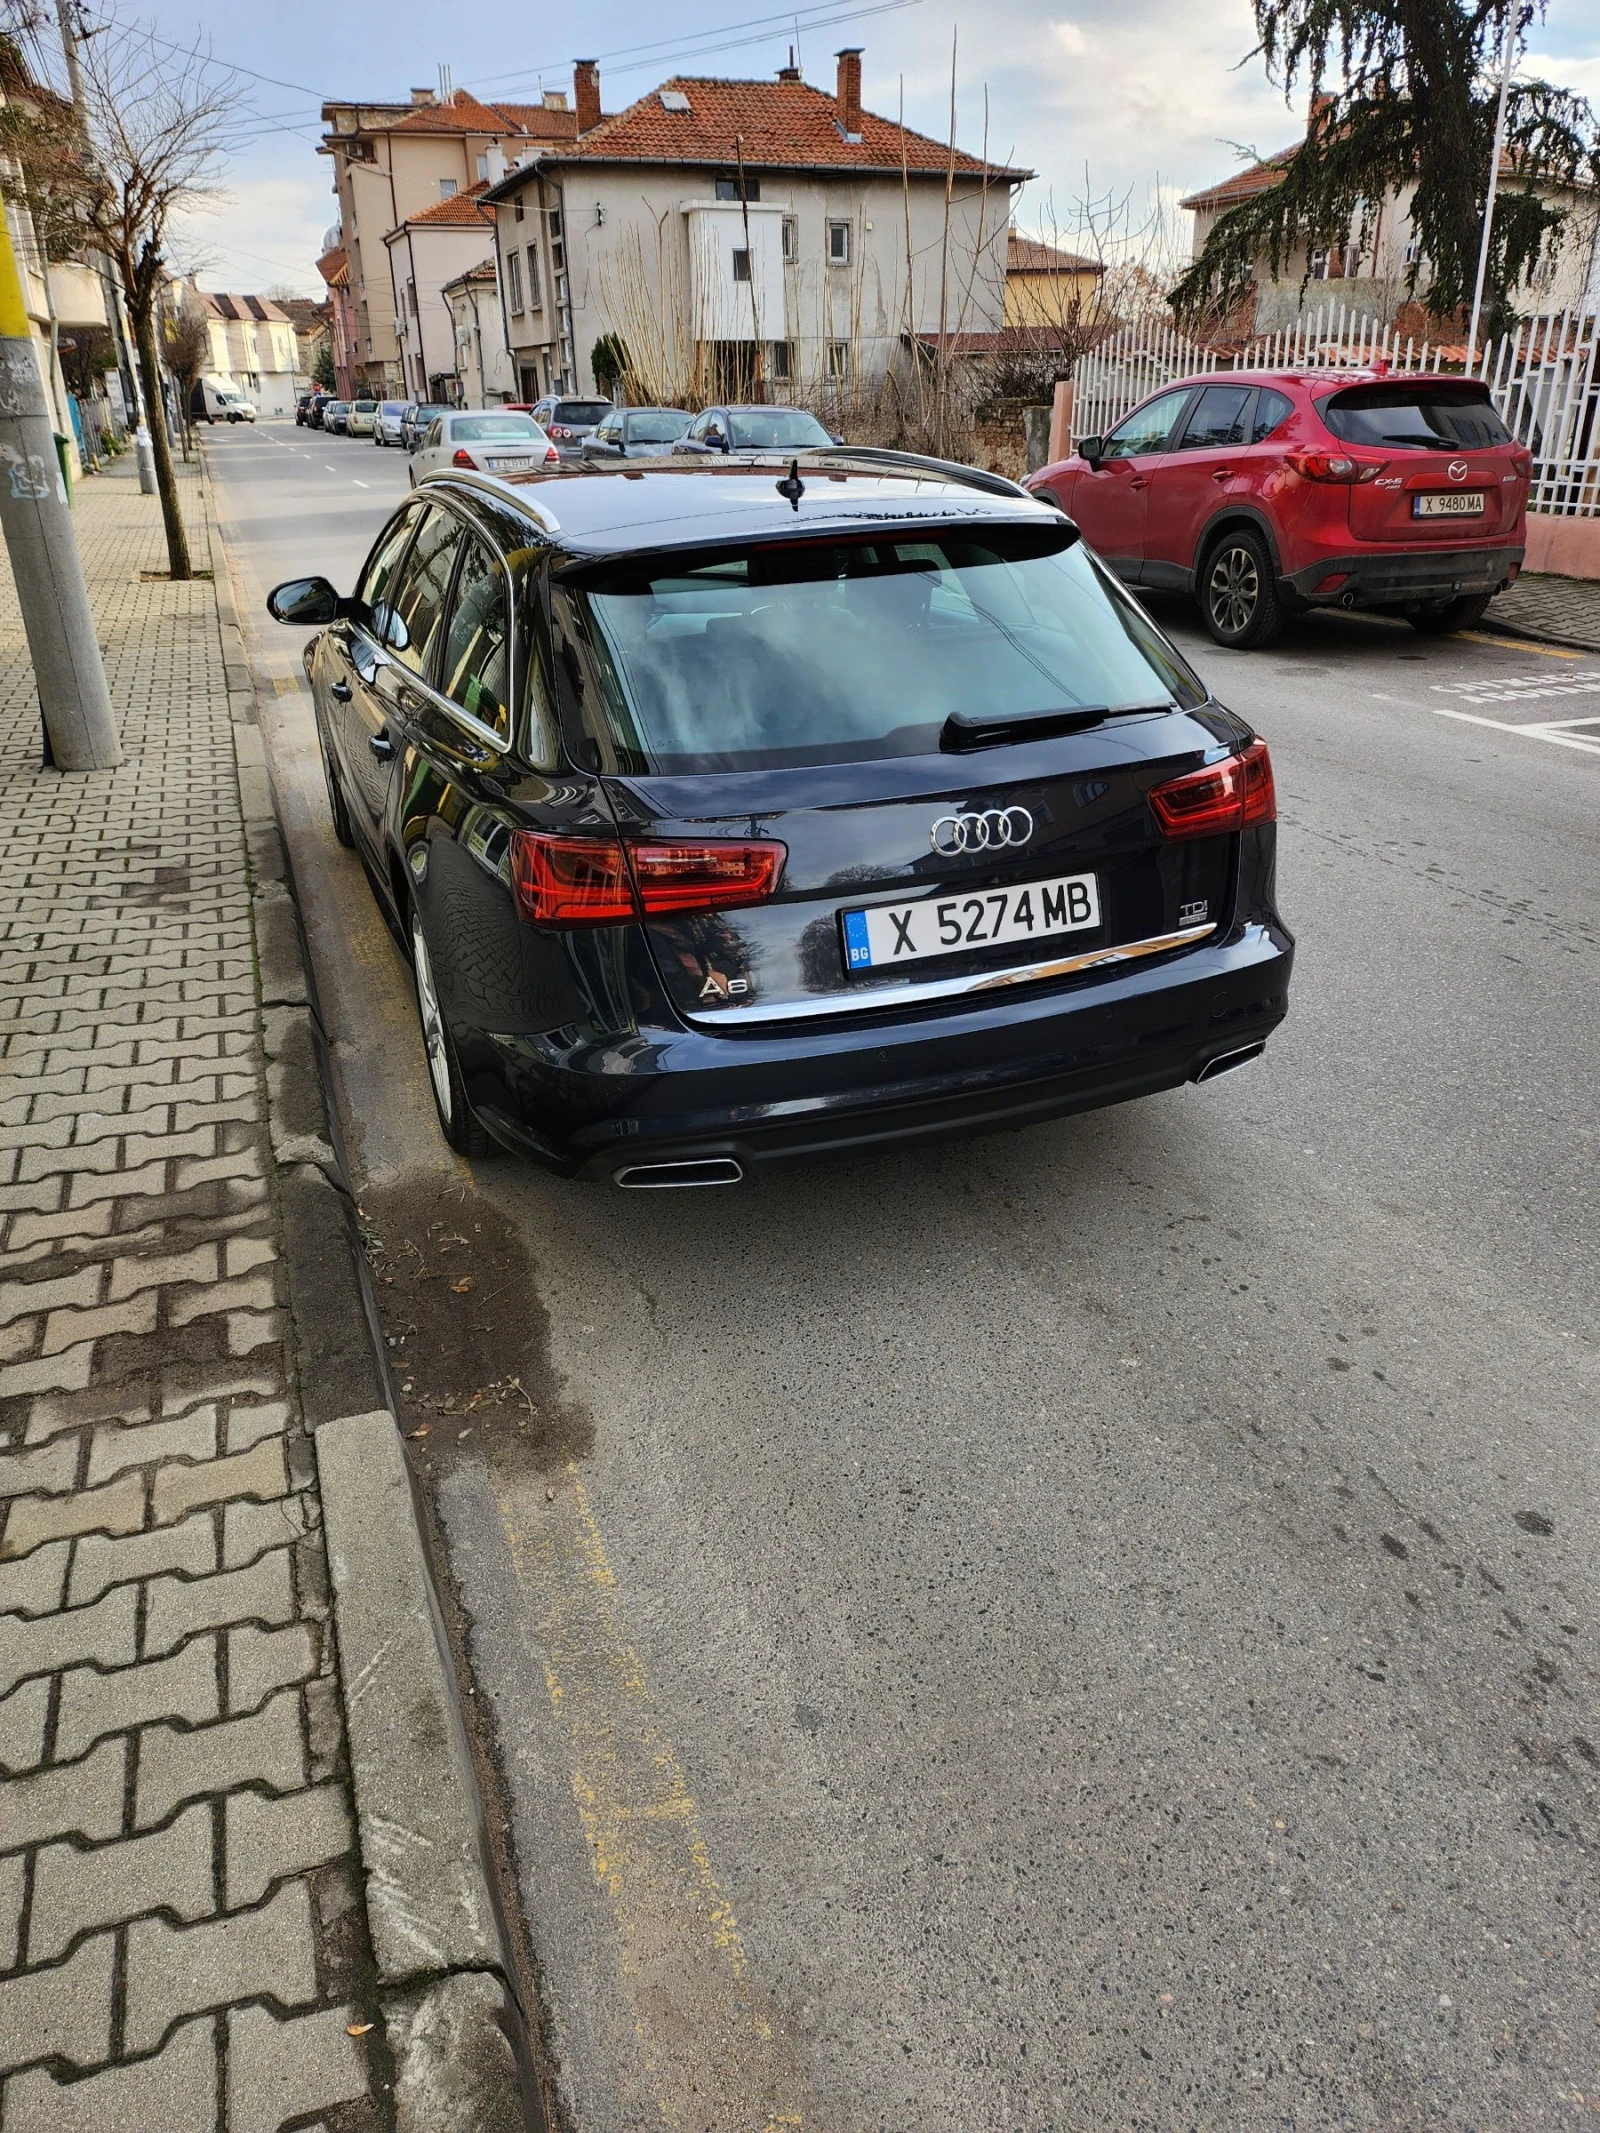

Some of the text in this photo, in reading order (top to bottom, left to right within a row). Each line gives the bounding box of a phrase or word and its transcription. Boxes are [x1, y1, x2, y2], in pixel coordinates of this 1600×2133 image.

[1375, 477, 1403, 486] CX-5
[1426, 499, 1433, 513] X
[1180, 899, 1208, 916] TDI
[889, 909, 917, 956] X
[851, 946, 869, 962] BG
[698, 976, 748, 998] A6
